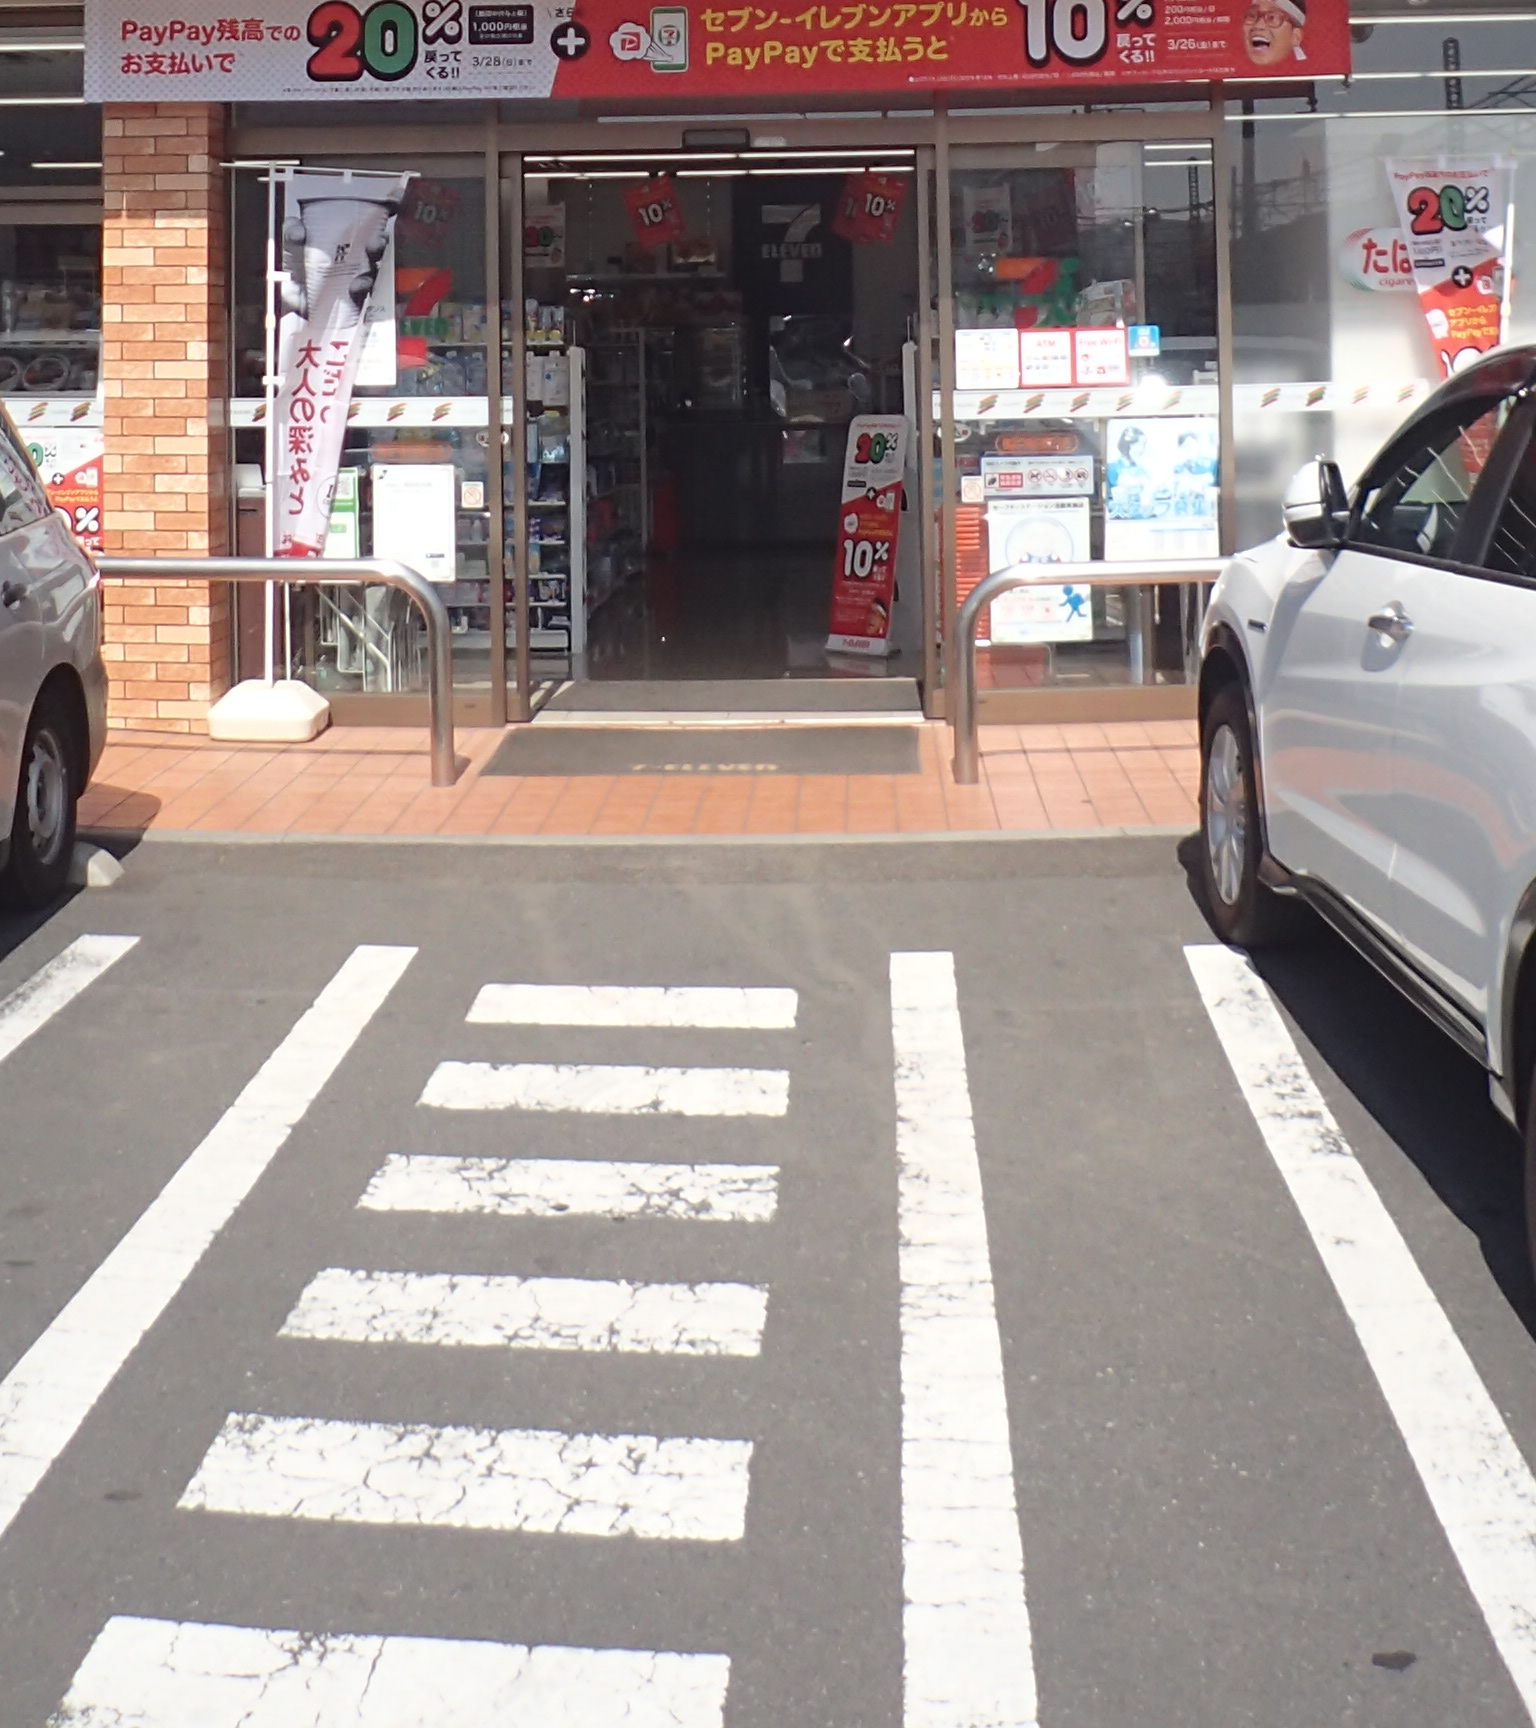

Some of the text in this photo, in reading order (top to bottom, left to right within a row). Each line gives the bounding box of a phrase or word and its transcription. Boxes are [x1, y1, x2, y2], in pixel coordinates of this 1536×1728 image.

[121, 18, 301, 46] PayPay残高での
[1116, 33, 1157, 48] 戻って
[121, 52, 236, 75] お支払いで
[424, 50, 462, 63] 戻って
[705, 35, 949, 70] PayPayで支払うと
